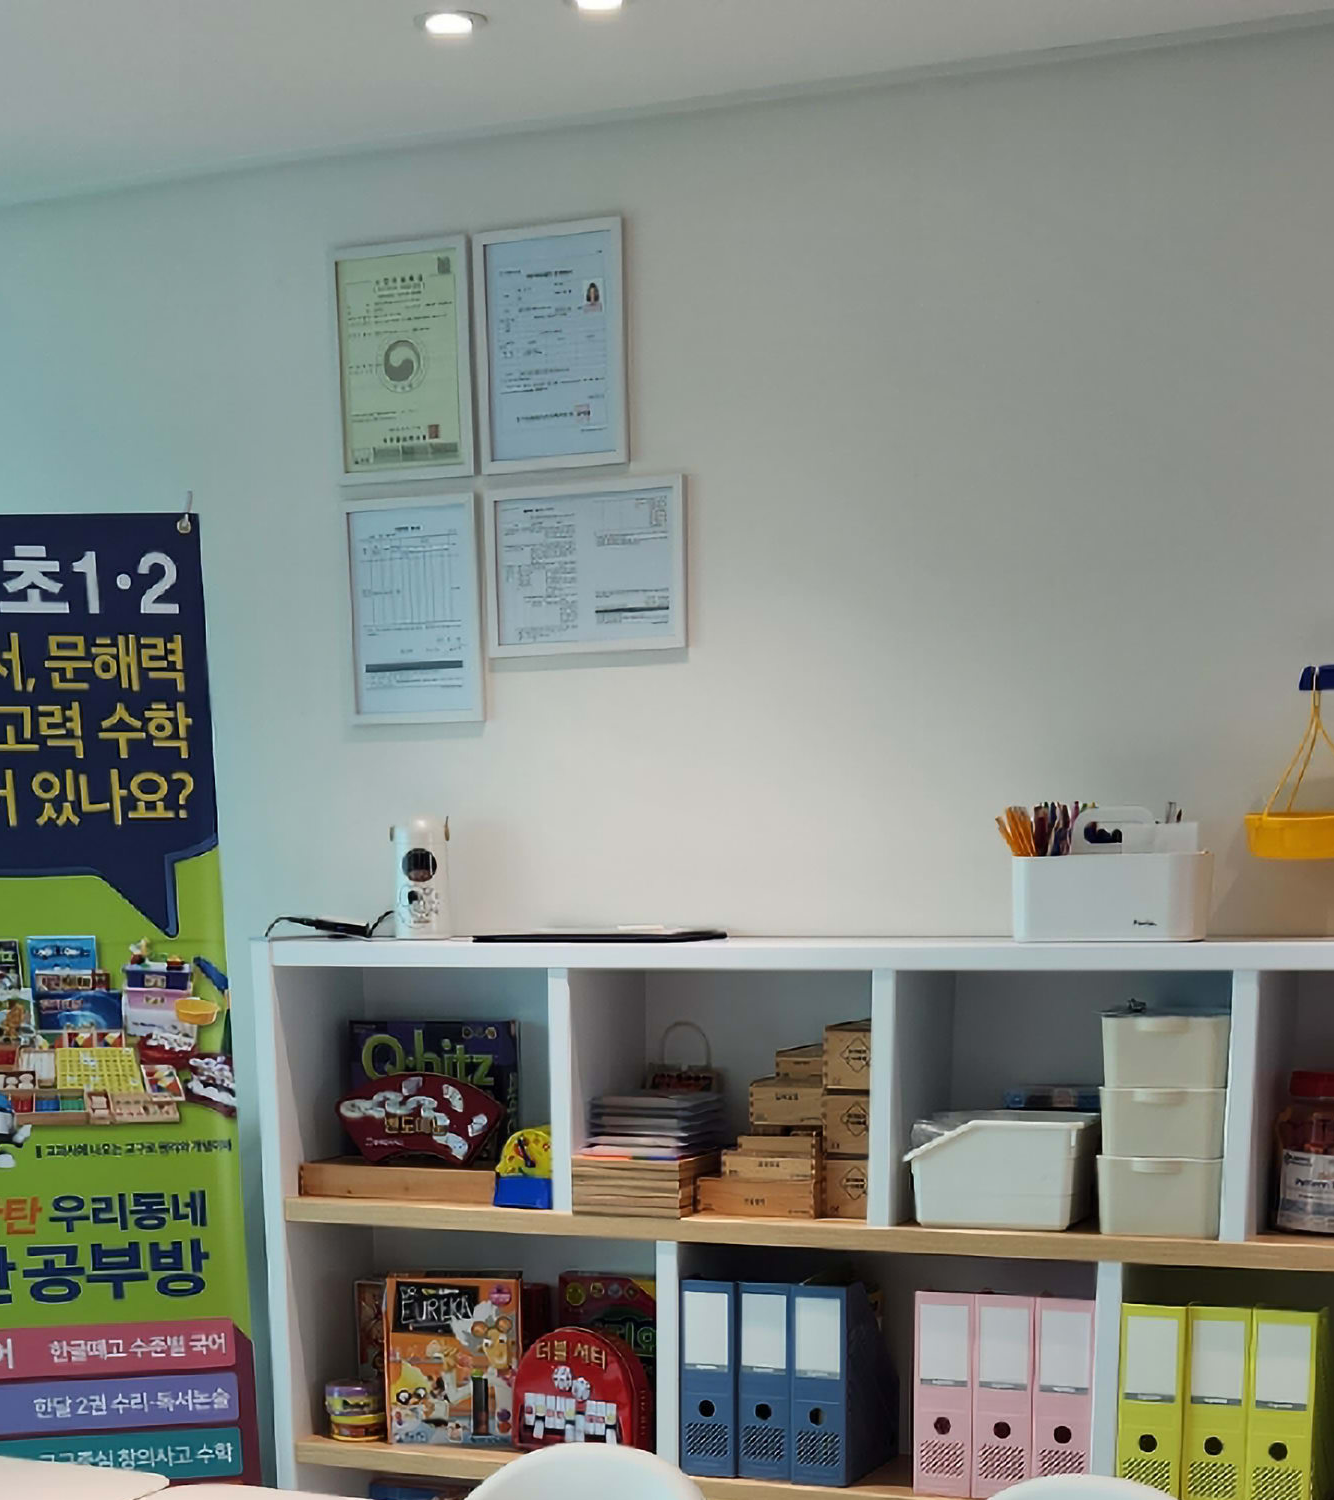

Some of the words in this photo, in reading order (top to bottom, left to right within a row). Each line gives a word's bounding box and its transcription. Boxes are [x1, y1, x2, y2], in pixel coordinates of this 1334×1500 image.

[98, 701, 193, 760] 수학
[31, 767, 195, 828] 있나요?
[49, 1189, 209, 1233] 우리동네
[401, 1294, 473, 1324] EUREKA
[189, 1333, 228, 1355] 국어
[33, 1396, 72, 1420] 한달
[118, 1444, 194, 1470] 창의사고
[196, 1442, 234, 1464] 수학
